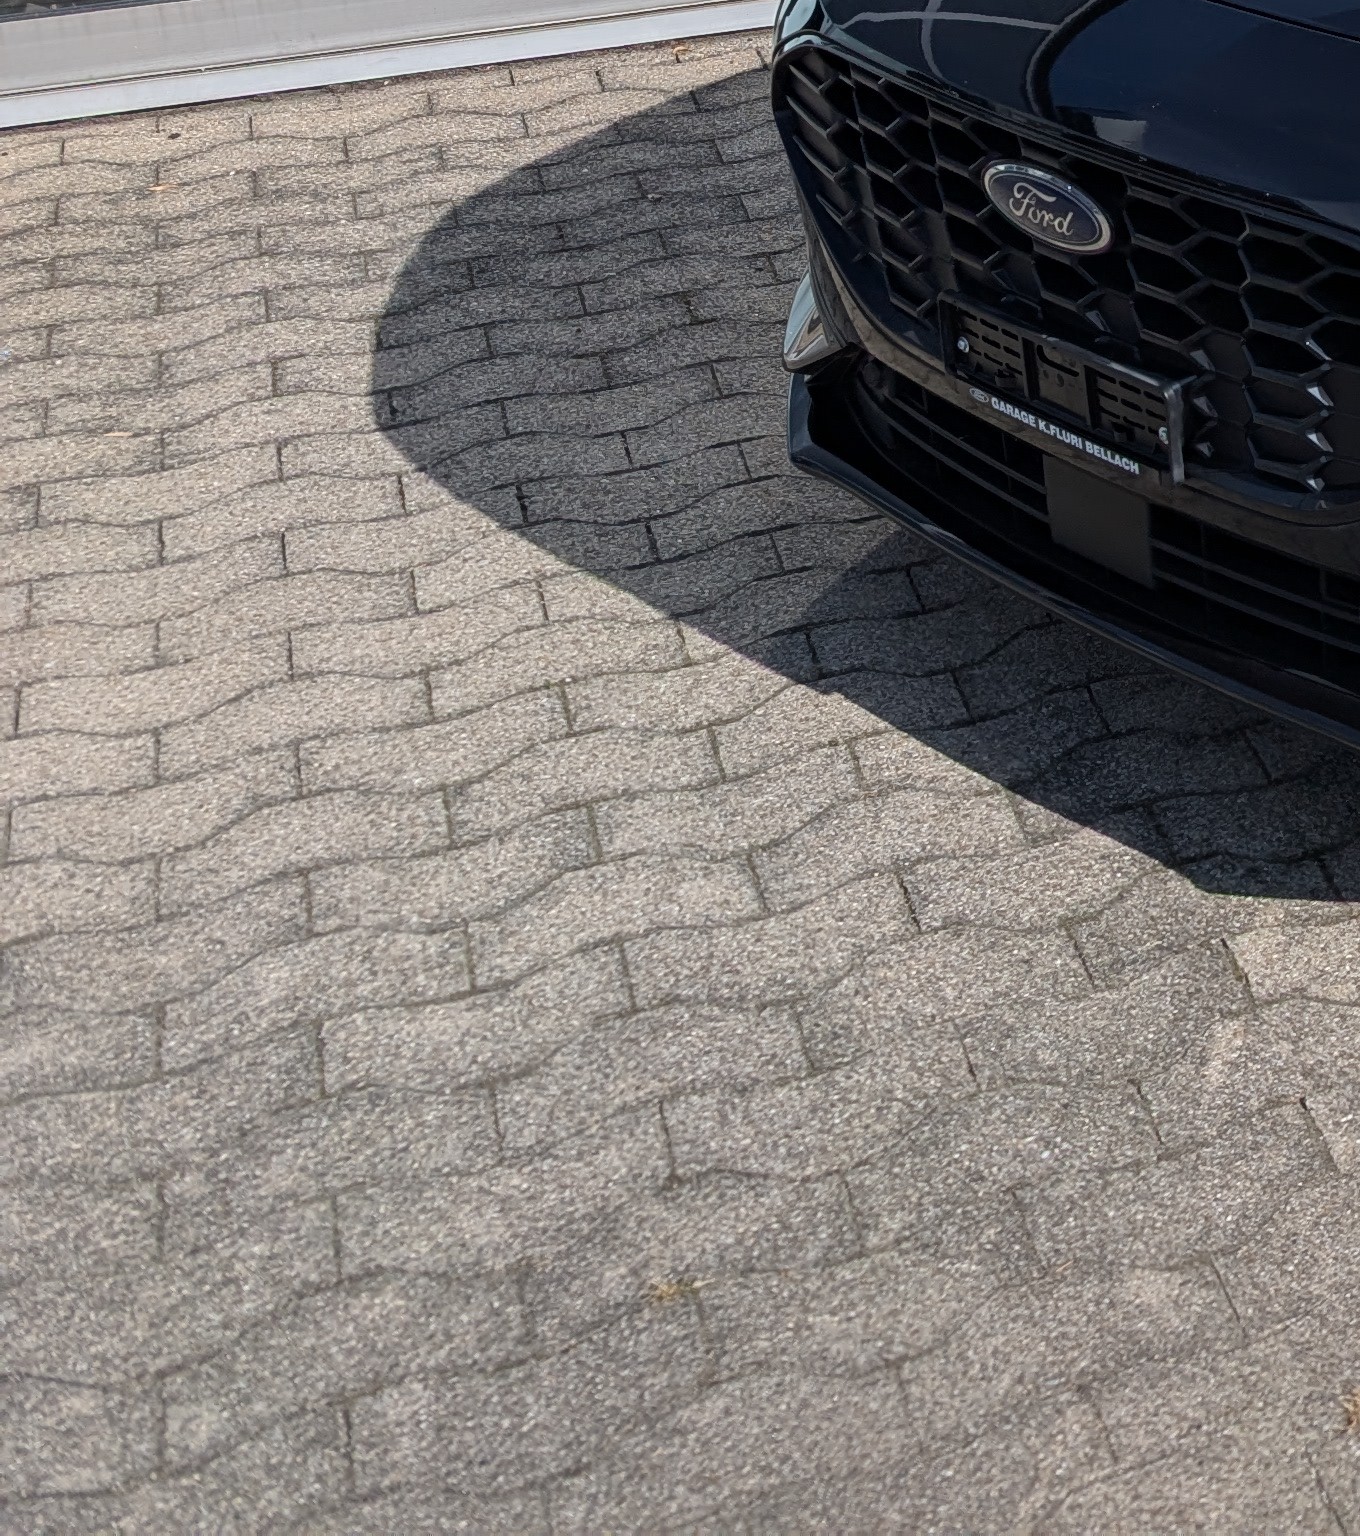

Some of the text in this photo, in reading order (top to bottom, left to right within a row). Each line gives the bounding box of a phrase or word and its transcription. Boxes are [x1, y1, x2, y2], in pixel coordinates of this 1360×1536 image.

[1008, 182, 1073, 237] Ford
[991, 396, 1036, 426] GARAGE
[1085, 440, 1140, 475] BELLACH
